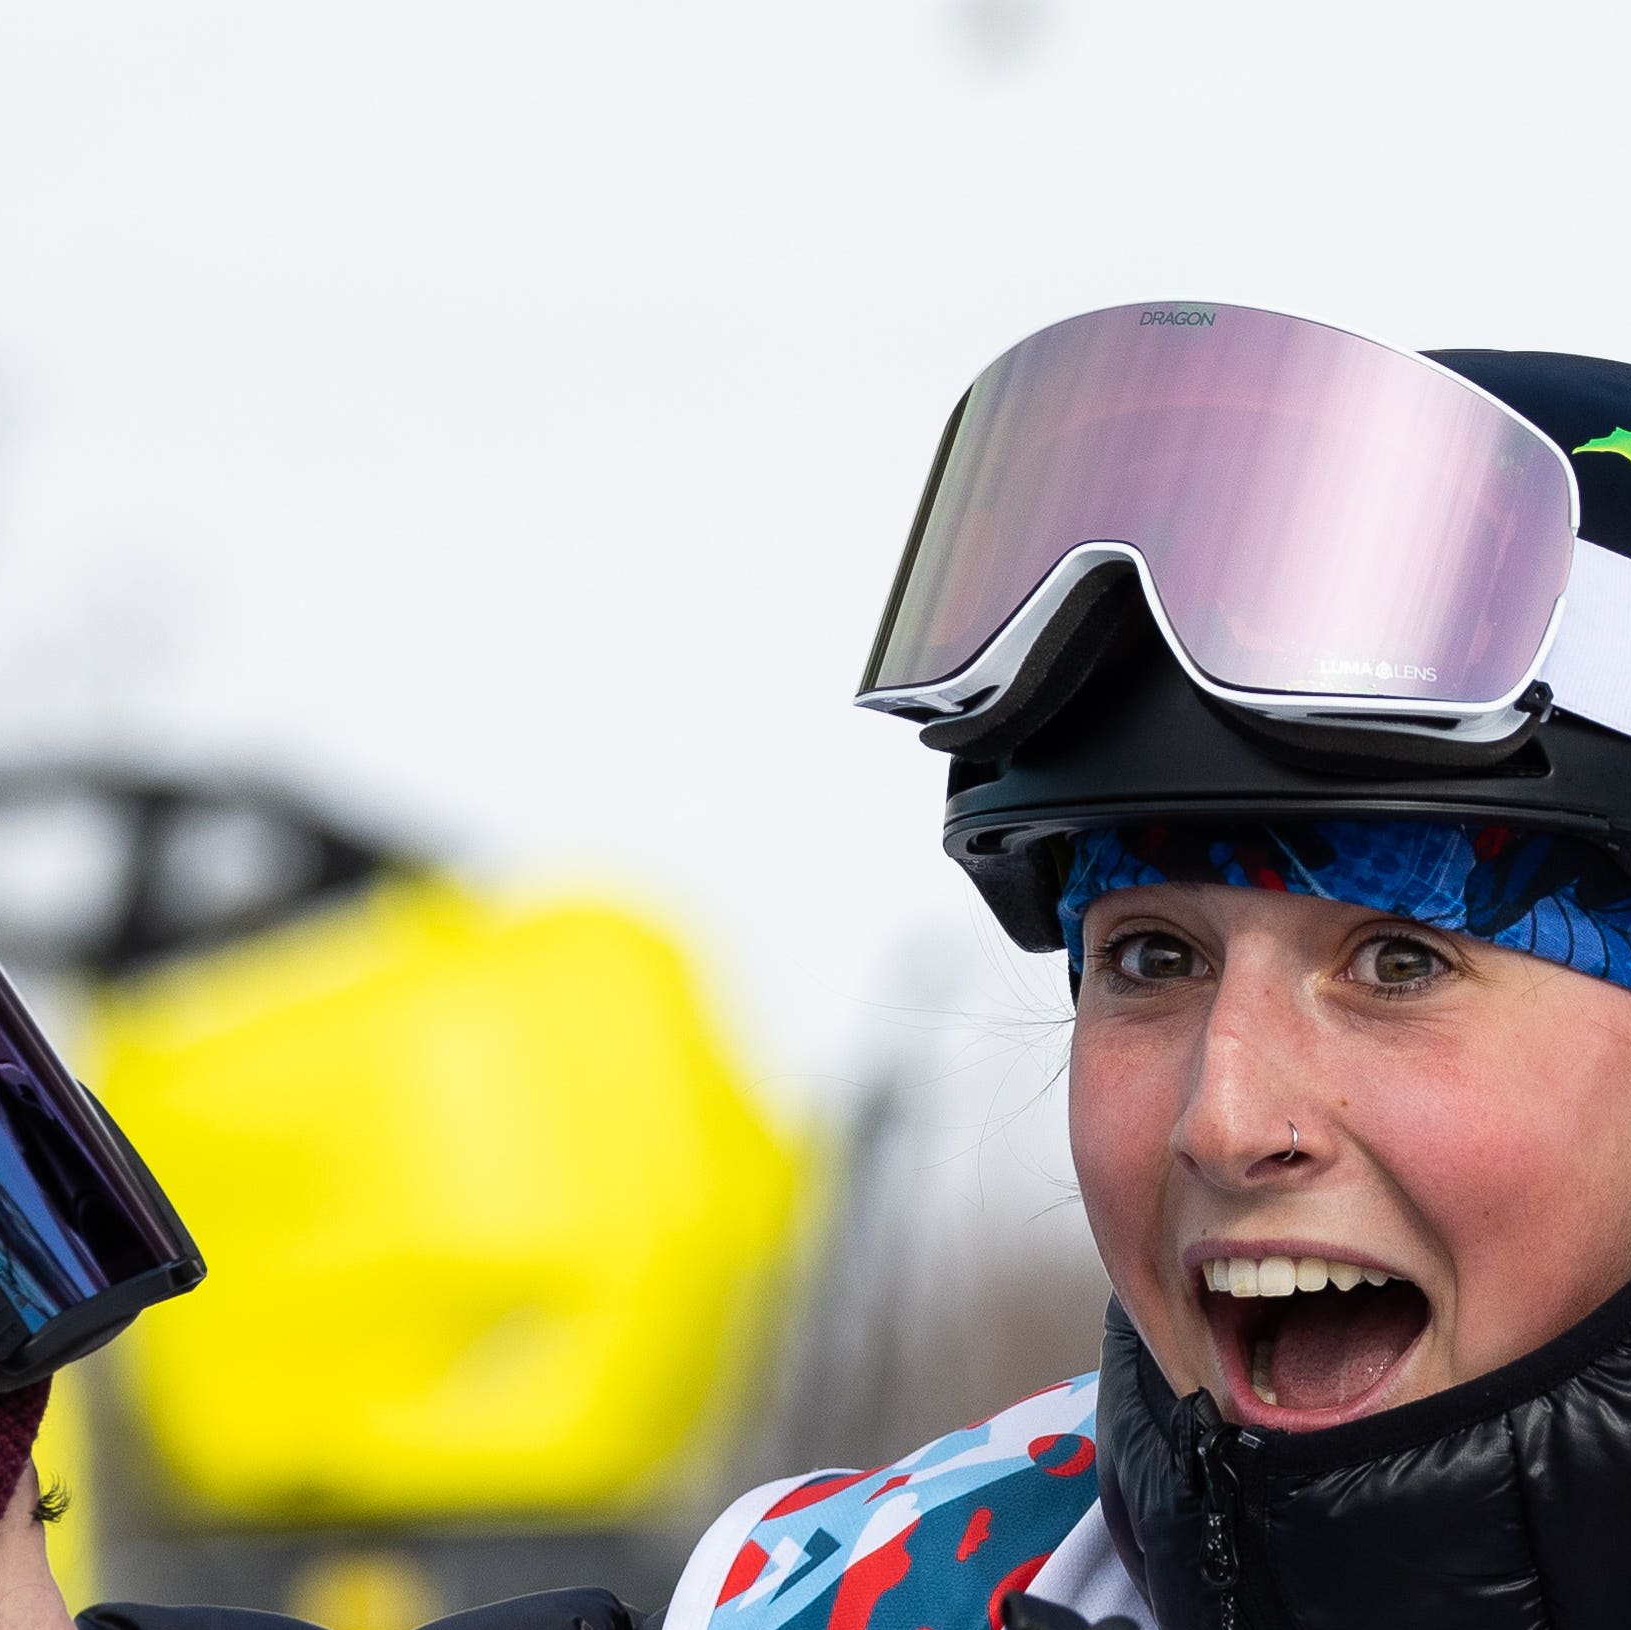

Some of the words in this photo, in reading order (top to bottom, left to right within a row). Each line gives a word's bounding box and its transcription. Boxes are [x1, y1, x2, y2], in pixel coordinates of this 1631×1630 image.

[1139, 311, 1216, 326] DRAGON
[1319, 659, 1373, 675] LUMA
[1393, 663, 1438, 682] LENS
